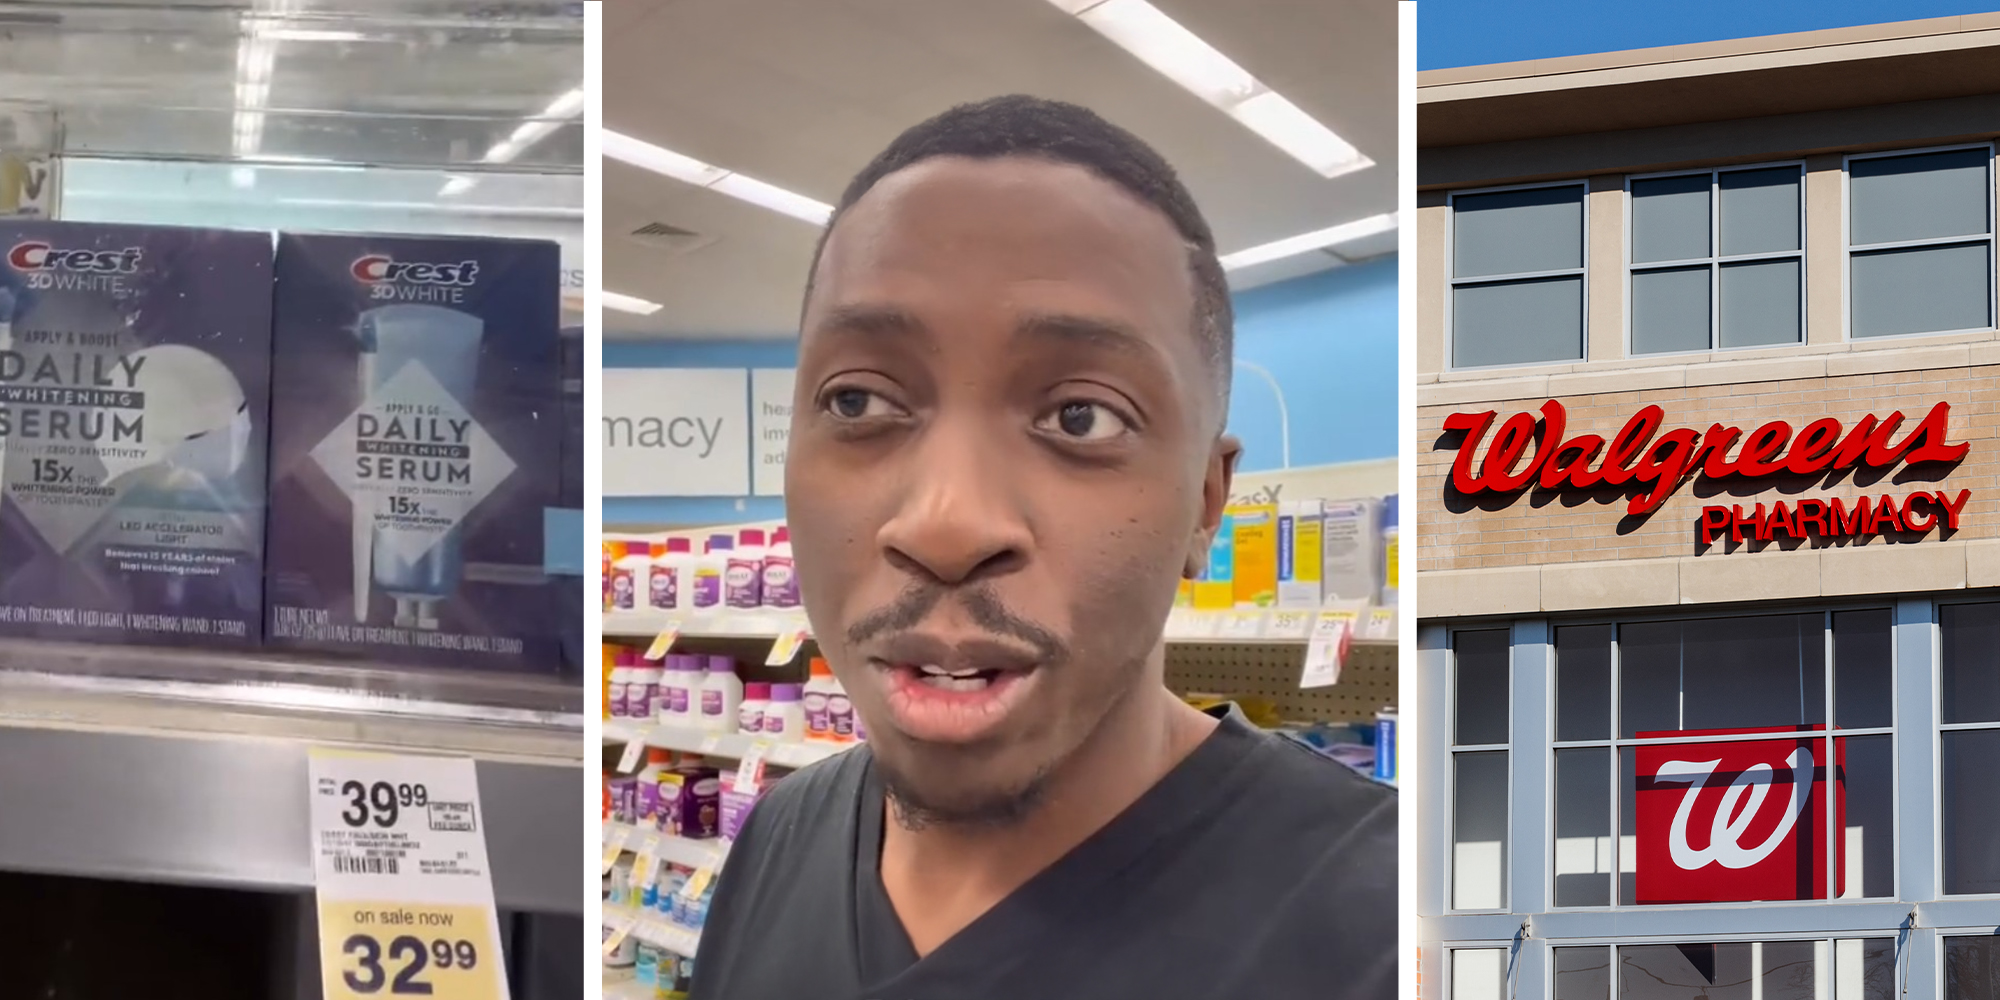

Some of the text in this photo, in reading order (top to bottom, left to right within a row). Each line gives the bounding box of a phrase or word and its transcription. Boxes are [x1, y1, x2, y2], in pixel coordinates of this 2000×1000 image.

[9, 241, 143, 272] Crest
[351, 254, 479, 286] Crest
[24, 331, 61, 345] APPLY
[0, 351, 146, 388] DAILY
[8, 388, 132, 407] WHITENING
[0, 409, 143, 443] SERUM
[357, 414, 471, 443] DAILY
[366, 441, 460, 457] WHITENING
[1442, 399, 1972, 516] Walgreens
[356, 456, 471, 484] SERUM
[1702, 488, 1972, 545] PHARMACY
[1653, 746, 1815, 870] W
[354, 908, 454, 927] on sale now
